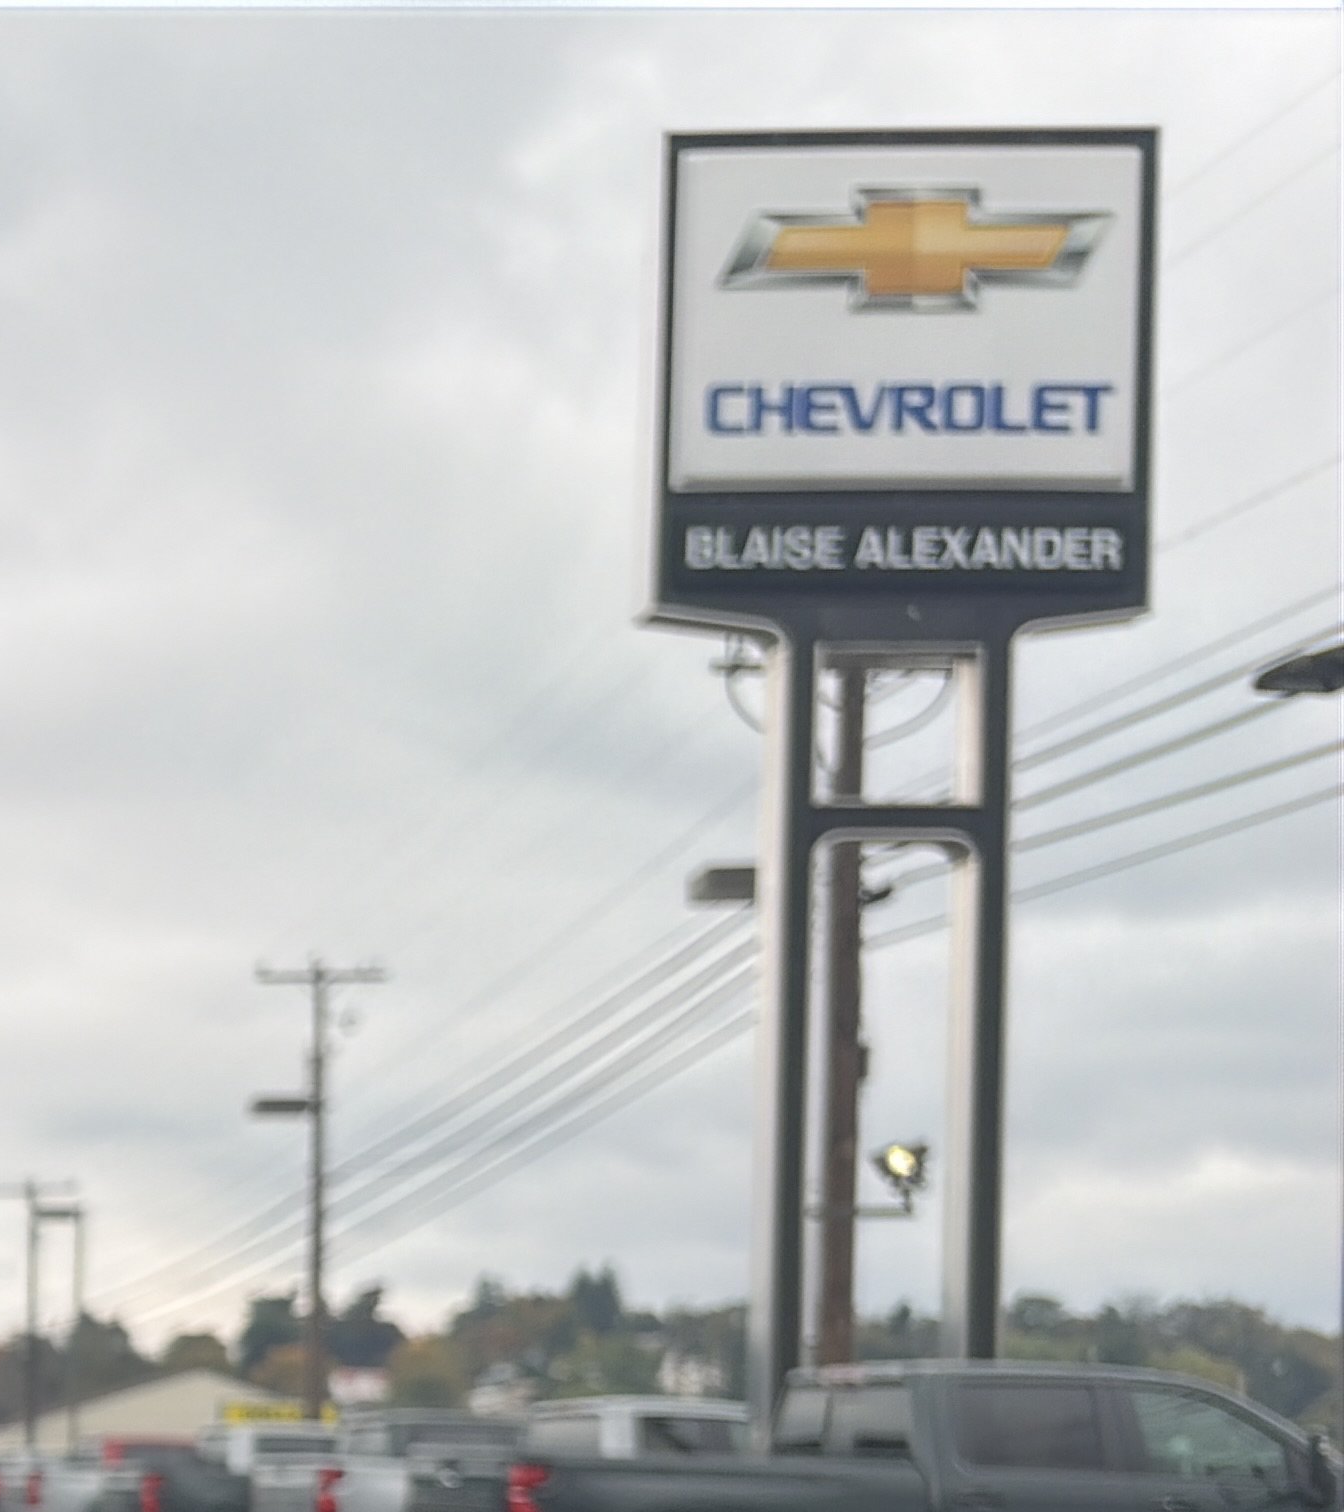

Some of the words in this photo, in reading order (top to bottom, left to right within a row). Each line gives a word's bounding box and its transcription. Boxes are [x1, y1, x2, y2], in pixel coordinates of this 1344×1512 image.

[707, 382, 1114, 435] CHEVROLET
[685, 526, 846, 570] BLAISE
[854, 526, 1124, 571] ALEXANDER
